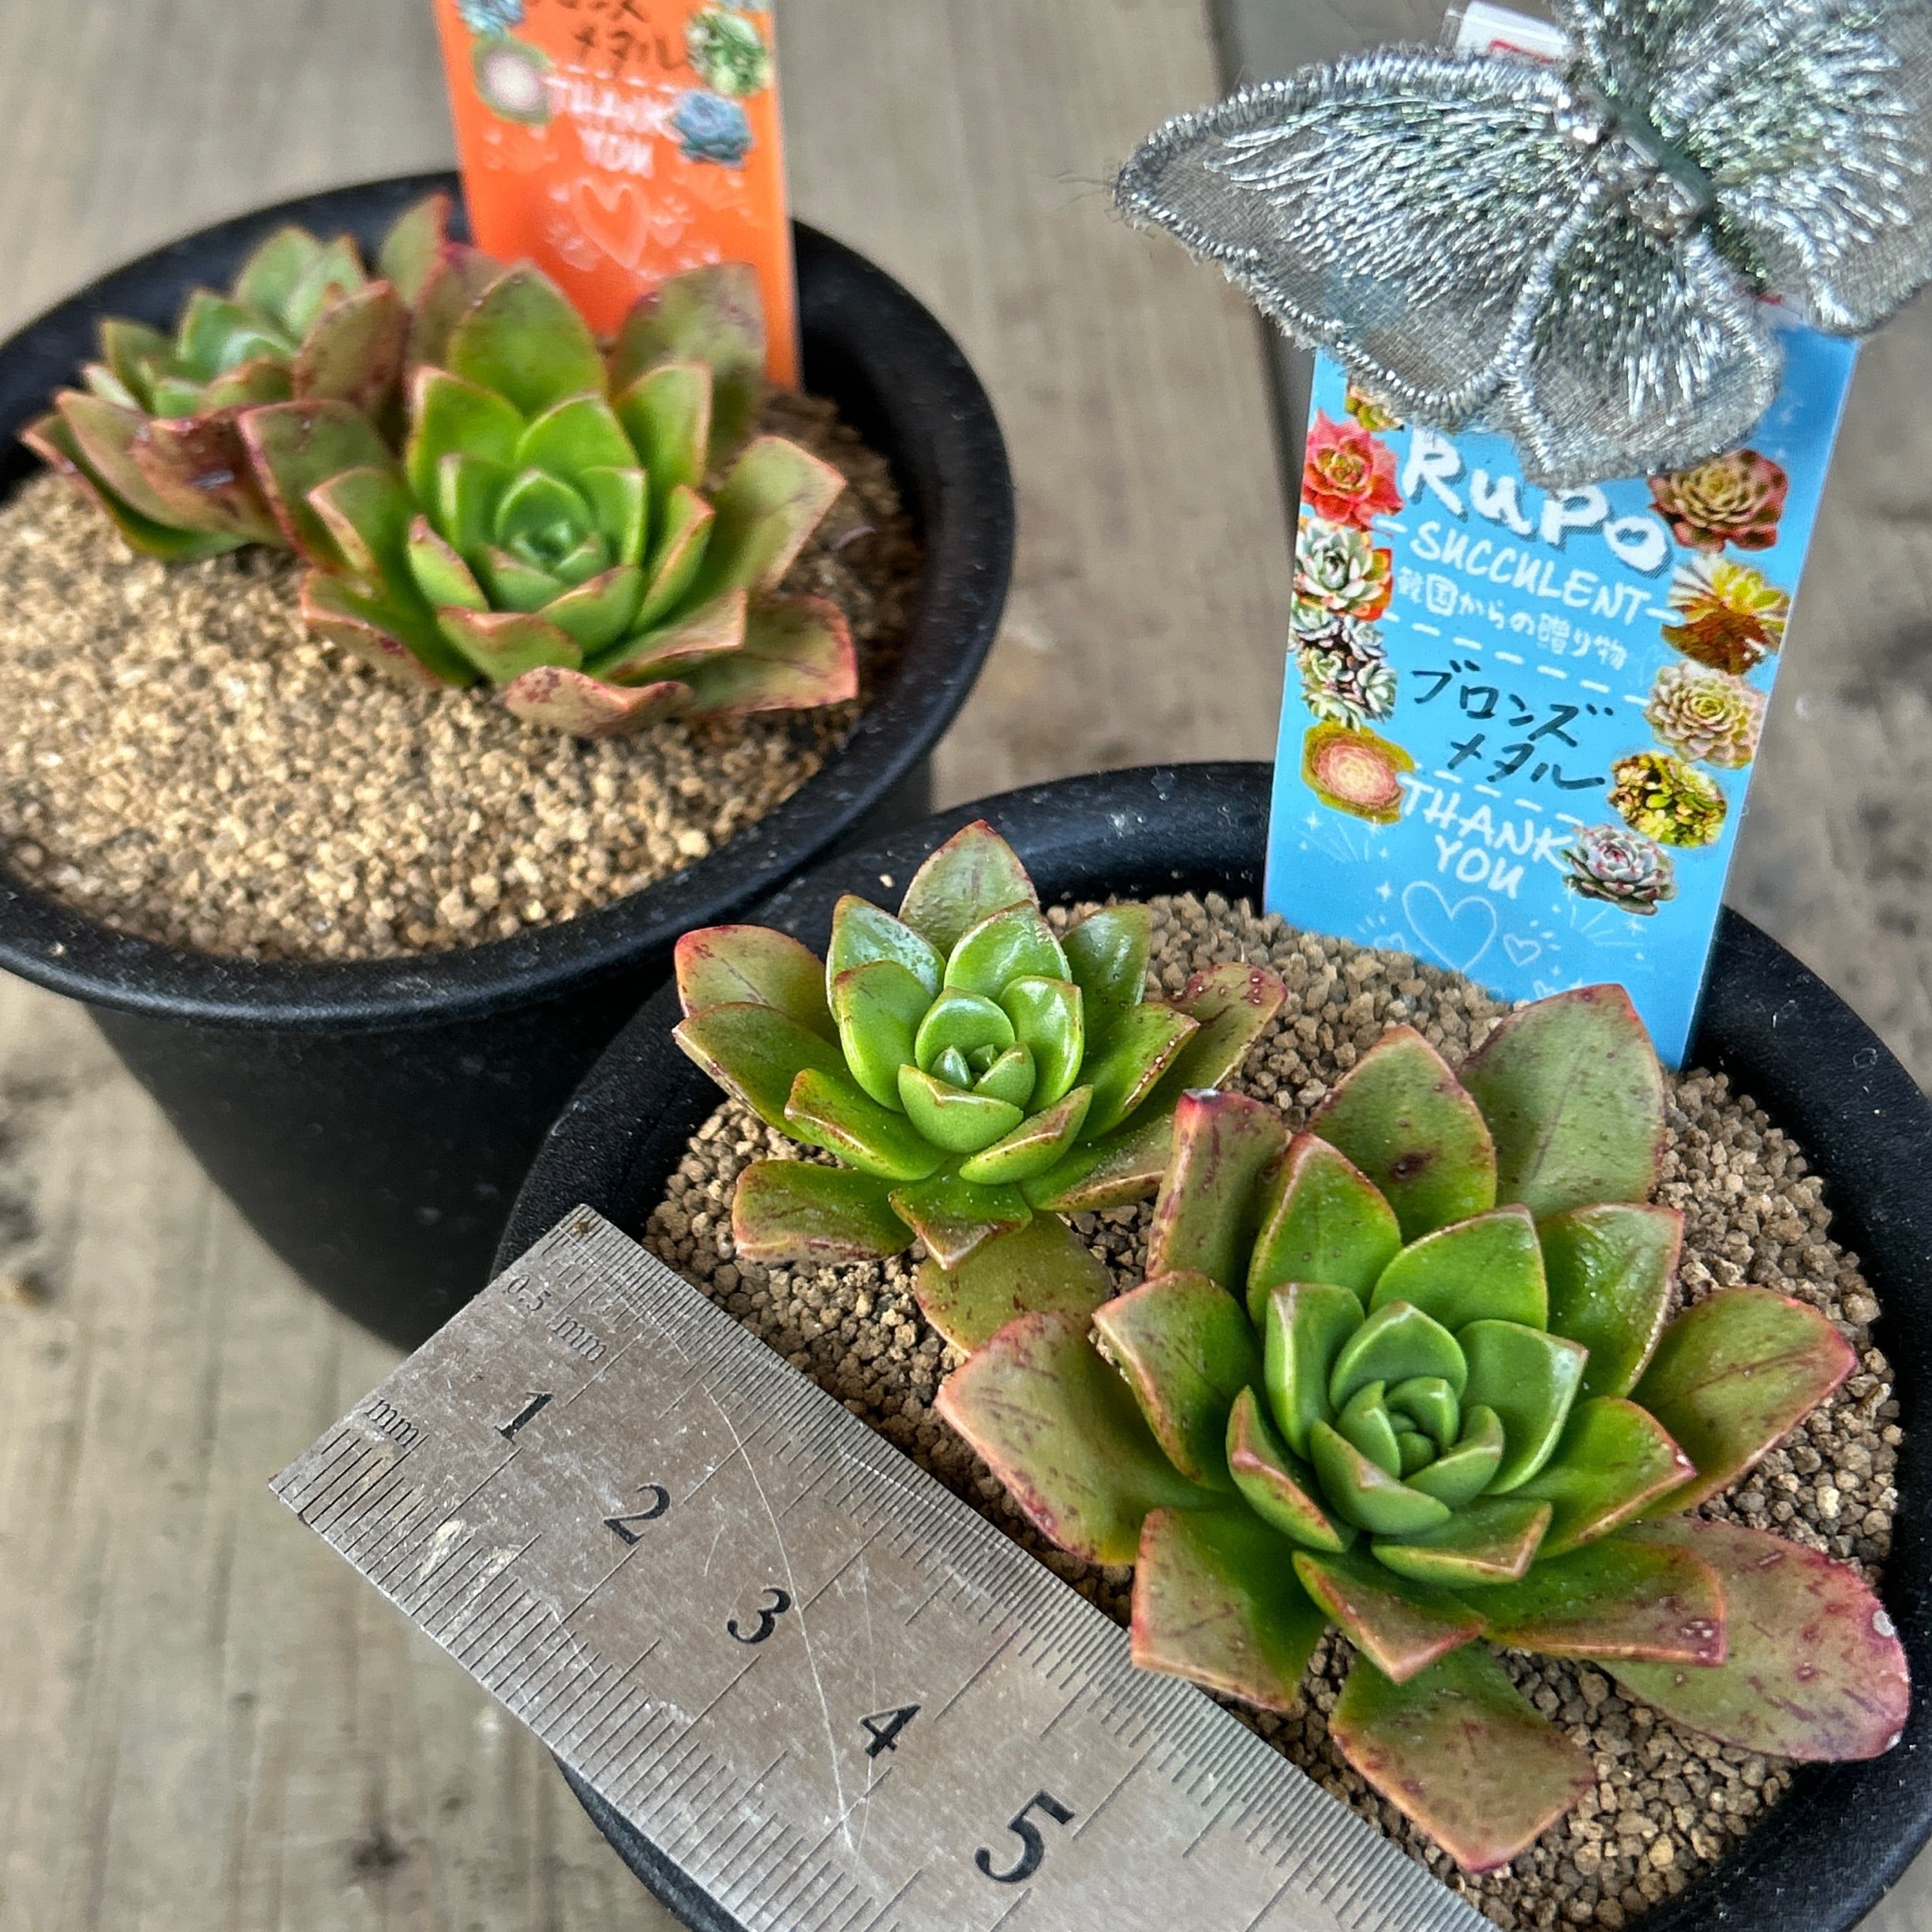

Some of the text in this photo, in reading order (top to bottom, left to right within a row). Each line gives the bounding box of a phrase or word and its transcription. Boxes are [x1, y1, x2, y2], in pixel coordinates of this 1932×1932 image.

[1410, 521, 1652, 625] SUCCULENT
[1410, 660, 1614, 747] ブロンズ
[1447, 733, 1605, 789] メタル
[1395, 771, 1574, 873] THANK
[1435, 834, 1525, 900] YOU
[507, 1274, 607, 1365] 0.5 mm
[364, 1398, 421, 1447] mm
[494, 1391, 552, 1444] 1
[603, 1482, 671, 1547] 2
[727, 1587, 791, 1644] 3
[859, 1703, 921, 1759] 4
[974, 1789, 1076, 1884] 5
